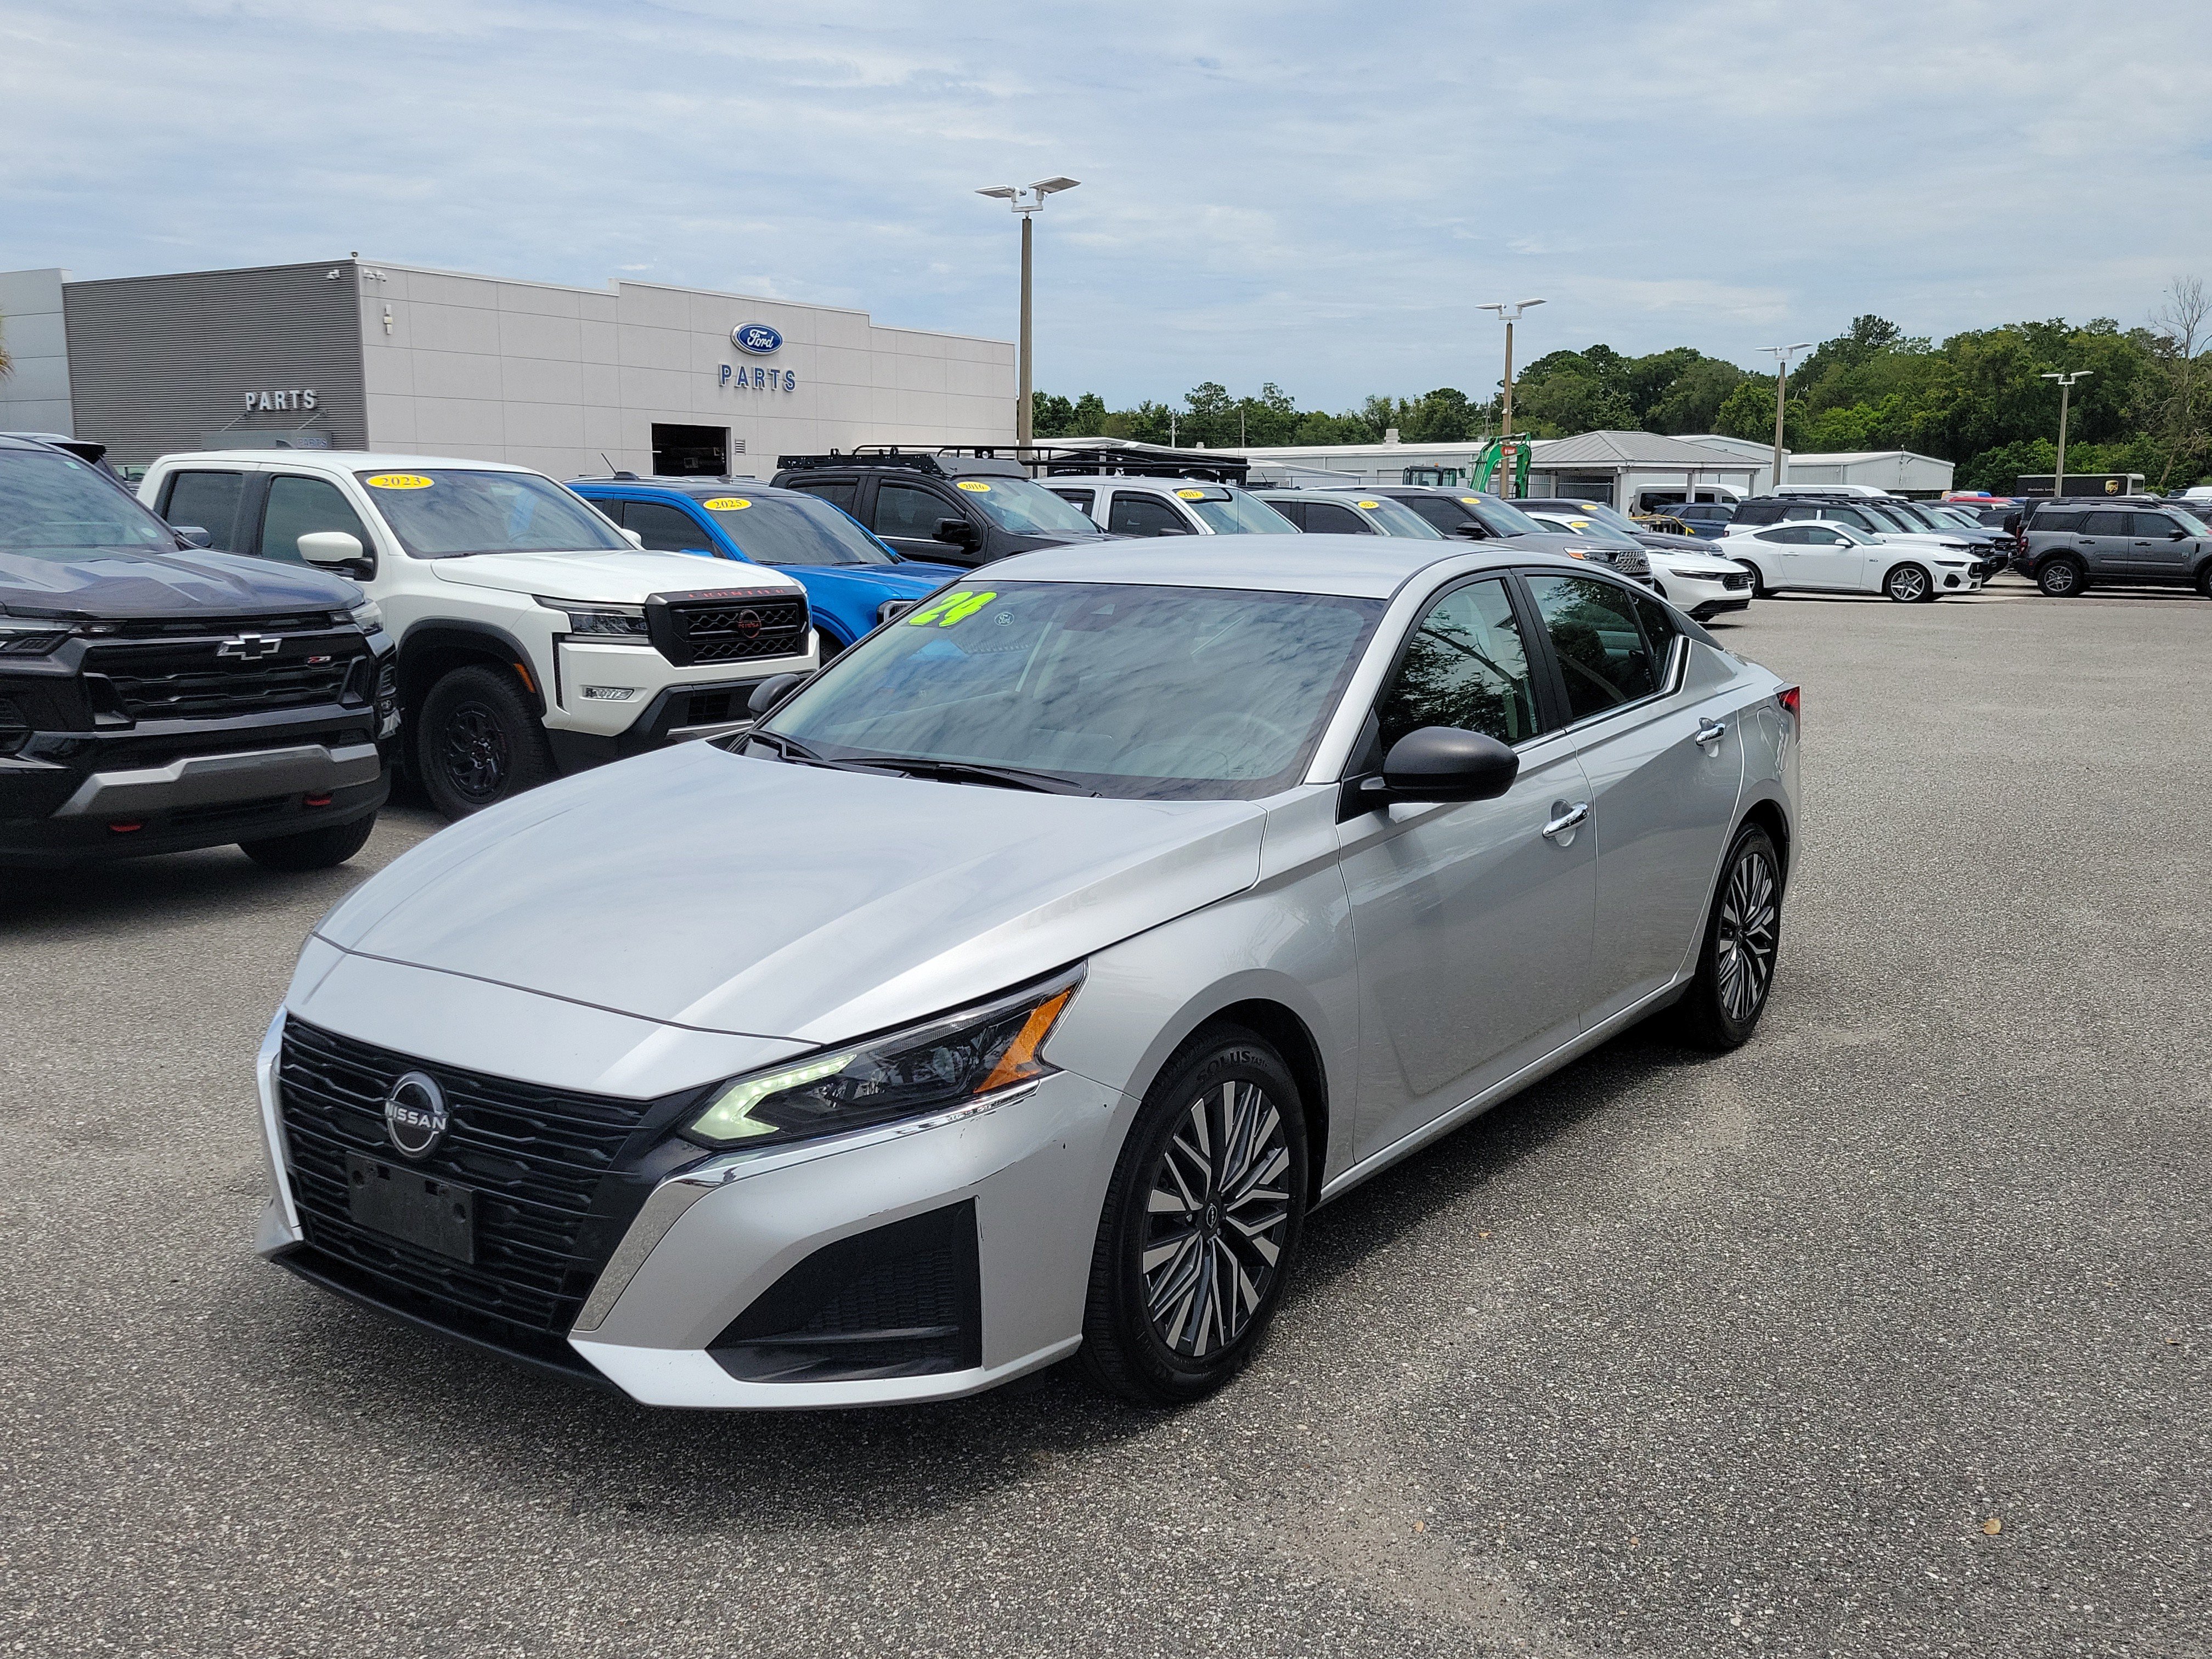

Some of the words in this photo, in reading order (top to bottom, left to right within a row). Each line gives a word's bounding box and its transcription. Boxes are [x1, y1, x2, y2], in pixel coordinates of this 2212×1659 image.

[747, 329, 774, 348] Ford
[718, 363, 795, 392] PARTS
[245, 389, 316, 411] PARTS
[380, 476, 421, 486] 2023
[2107, 484, 2119, 492] ups
[713, 499, 742, 509] 2025
[909, 591, 997, 627] 24
[1197, 1050, 1251, 1082] SOLUS
[385, 1101, 447, 1130] NISSAN
